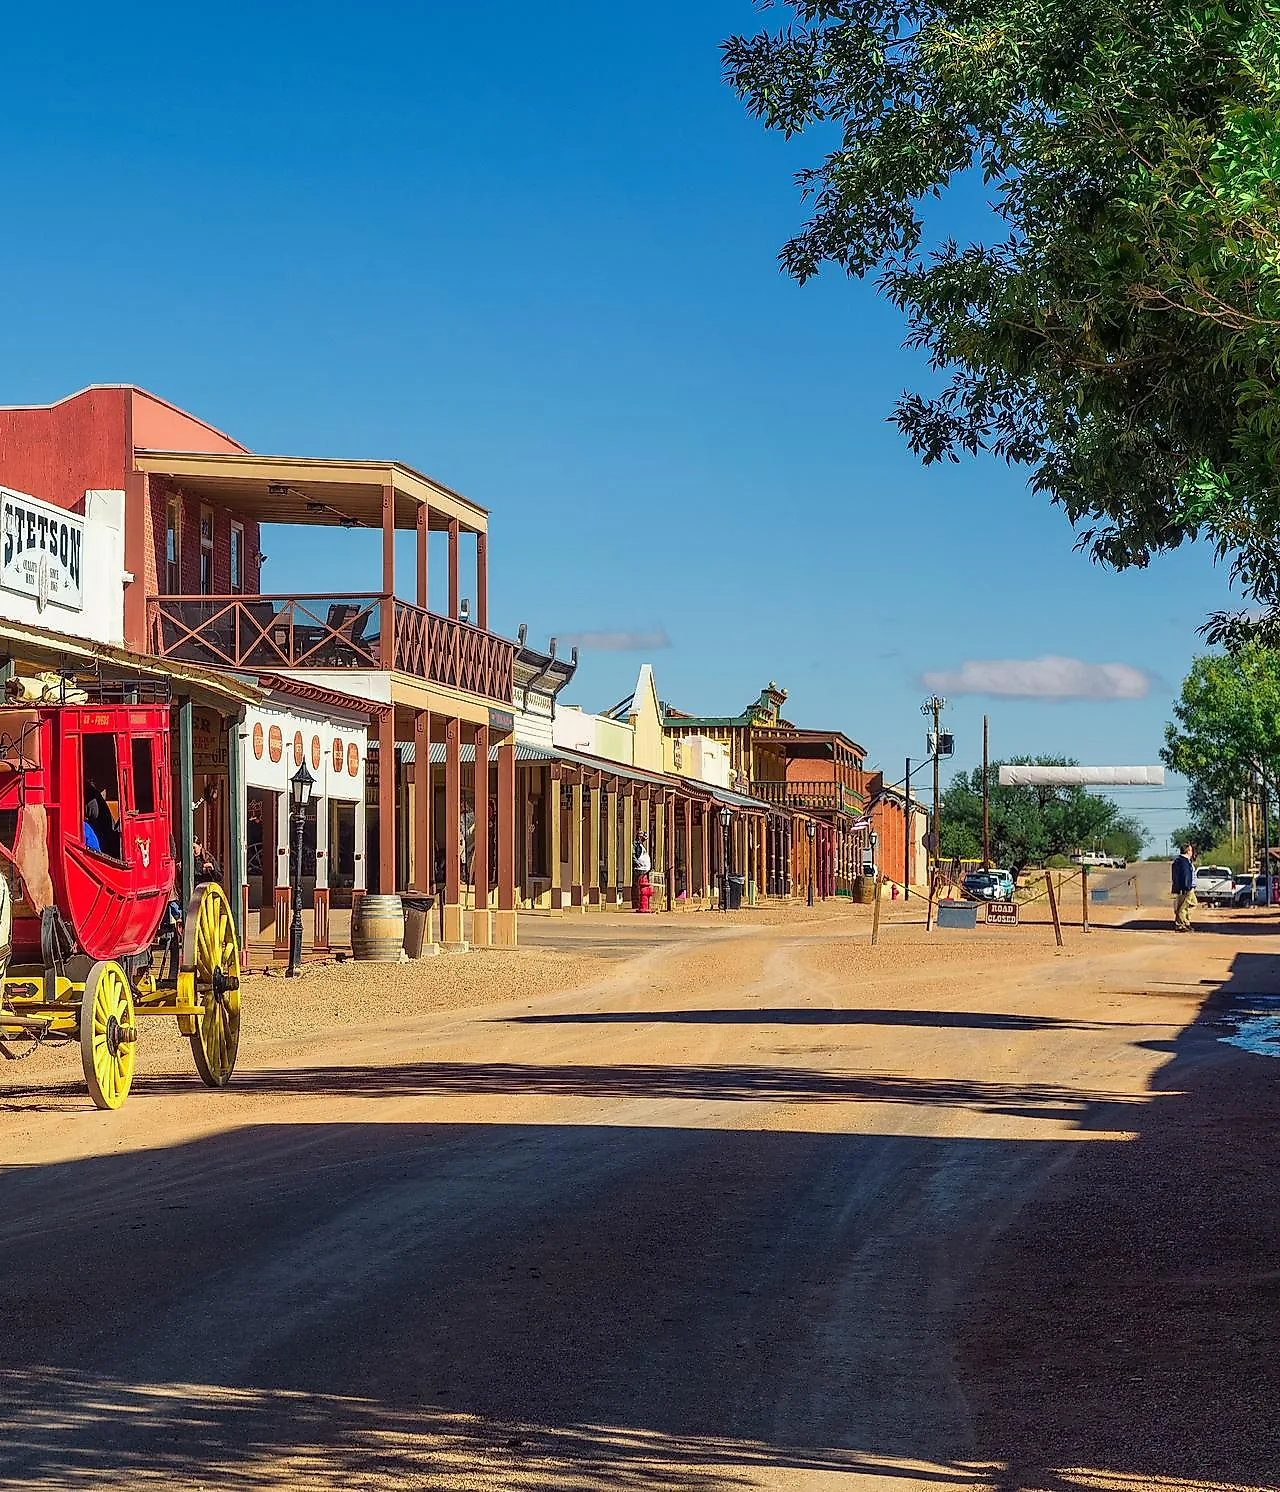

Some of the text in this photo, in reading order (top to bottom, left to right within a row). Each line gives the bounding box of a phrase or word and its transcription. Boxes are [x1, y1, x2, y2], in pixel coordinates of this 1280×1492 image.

[3, 502, 81, 592] STETSON
[991, 905, 1013, 913] ROAD
[988, 915, 1016, 923] CLOSED
